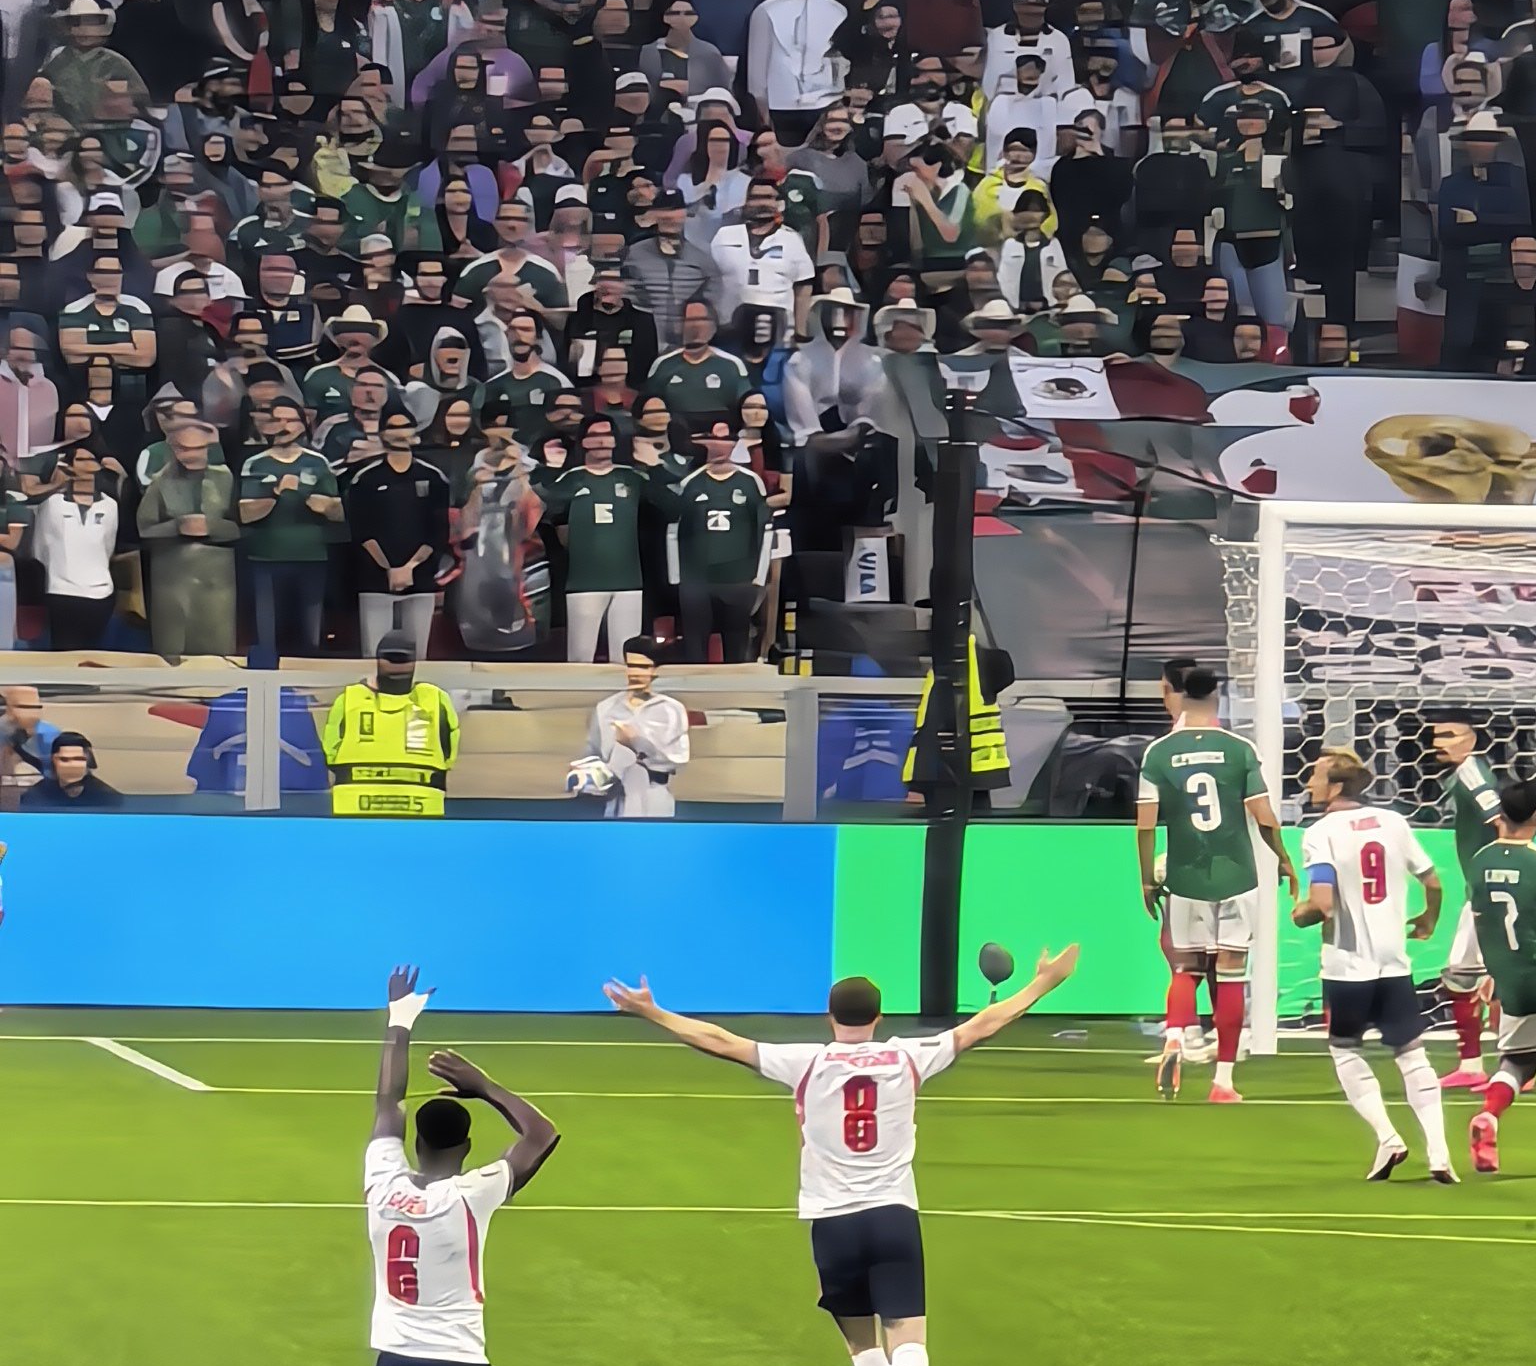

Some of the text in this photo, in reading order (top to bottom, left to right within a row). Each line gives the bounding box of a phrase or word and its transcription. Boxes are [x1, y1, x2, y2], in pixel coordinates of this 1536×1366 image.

[1186, 772, 1222, 832] 3
[1360, 841, 1387, 904] 9
[1490, 891, 1519, 951] 7
[843, 1075, 878, 1153] 8
